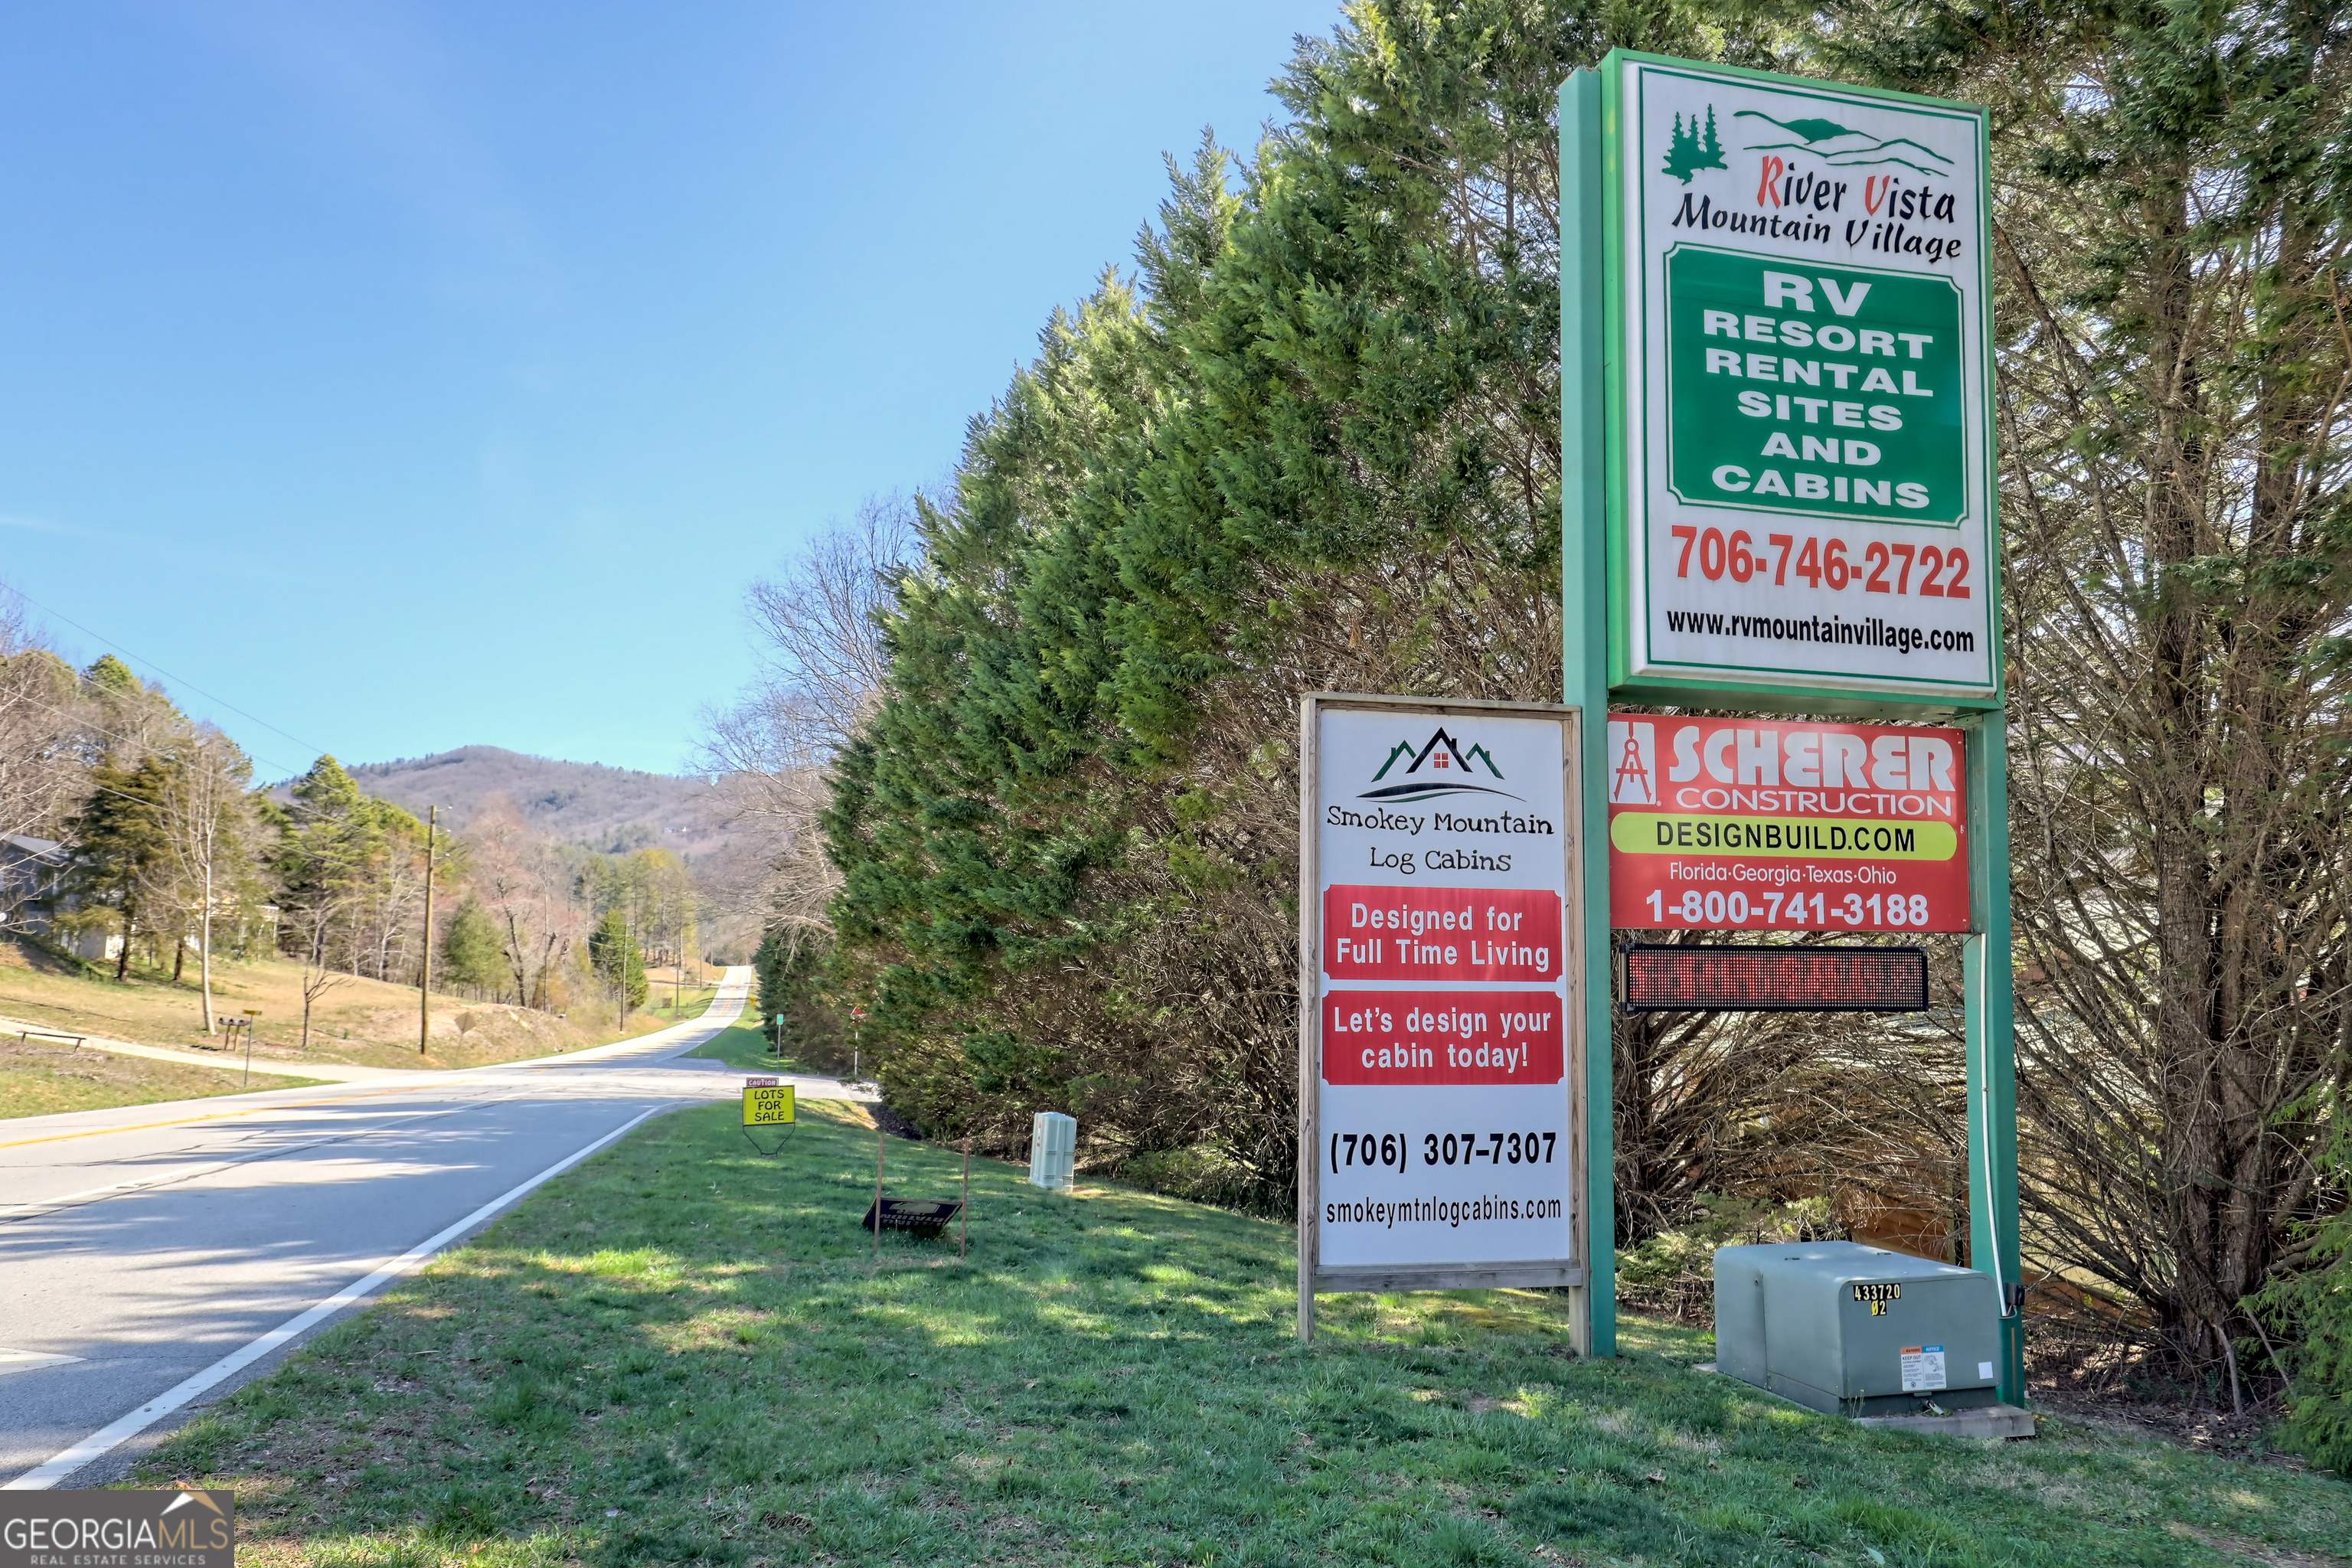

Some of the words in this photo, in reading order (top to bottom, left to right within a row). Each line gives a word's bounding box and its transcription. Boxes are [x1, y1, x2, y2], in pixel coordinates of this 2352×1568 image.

[1757, 155, 1847, 213] River
[1865, 175, 1955, 223] Vista
[1672, 192, 1831, 243] Mountain
[1846, 219, 1961, 264] Village
[1763, 270, 1872, 317] RV
[1704, 309, 1933, 359] RESORT
[1706, 348, 1933, 397] RENTAL
[1737, 390, 1903, 431] SITES
[1761, 432, 1882, 466] AND
[1712, 465, 1930, 508] CABINS
[1671, 524, 1970, 599] 706-746-2722
[1667, 610, 1974, 655] www.rvmountainvillage.com
[1669, 725, 1956, 792] SCHERER
[1676, 787, 1952, 816] CONSTRUCTION
[1327, 806, 1424, 835] Smokey
[1433, 811, 1554, 835] Mountain
[1657, 821, 1915, 852] DESIGNBUILD.COM
[1370, 847, 1416, 874] Log
[1425, 850, 1511, 871] Cabins
[1351, 903, 1473, 936] Designed
[1486, 906, 1523, 931] for
[1646, 889, 1929, 926] 1-800-741-3188
[1337, 938, 1382, 964] Full
[1396, 939, 1458, 965] Time
[1471, 940, 1549, 972] Living
[1406, 1007, 1488, 1038] design
[1500, 1011, 1551, 1038] your
[1361, 1043, 1433, 1068] cabin
[1447, 1042, 1528, 1073] today!
[754, 1089, 784, 1099] LOTS
[758, 1101, 781, 1110] FOR
[755, 1112, 784, 1122] SALE
[1331, 1133, 1406, 1174] (706)
[1423, 1132, 1557, 1165] 307-7307
[1326, 1194, 1561, 1229] smokeymtnlogcabins.com
[1855, 1284, 1900, 1300] 433720
